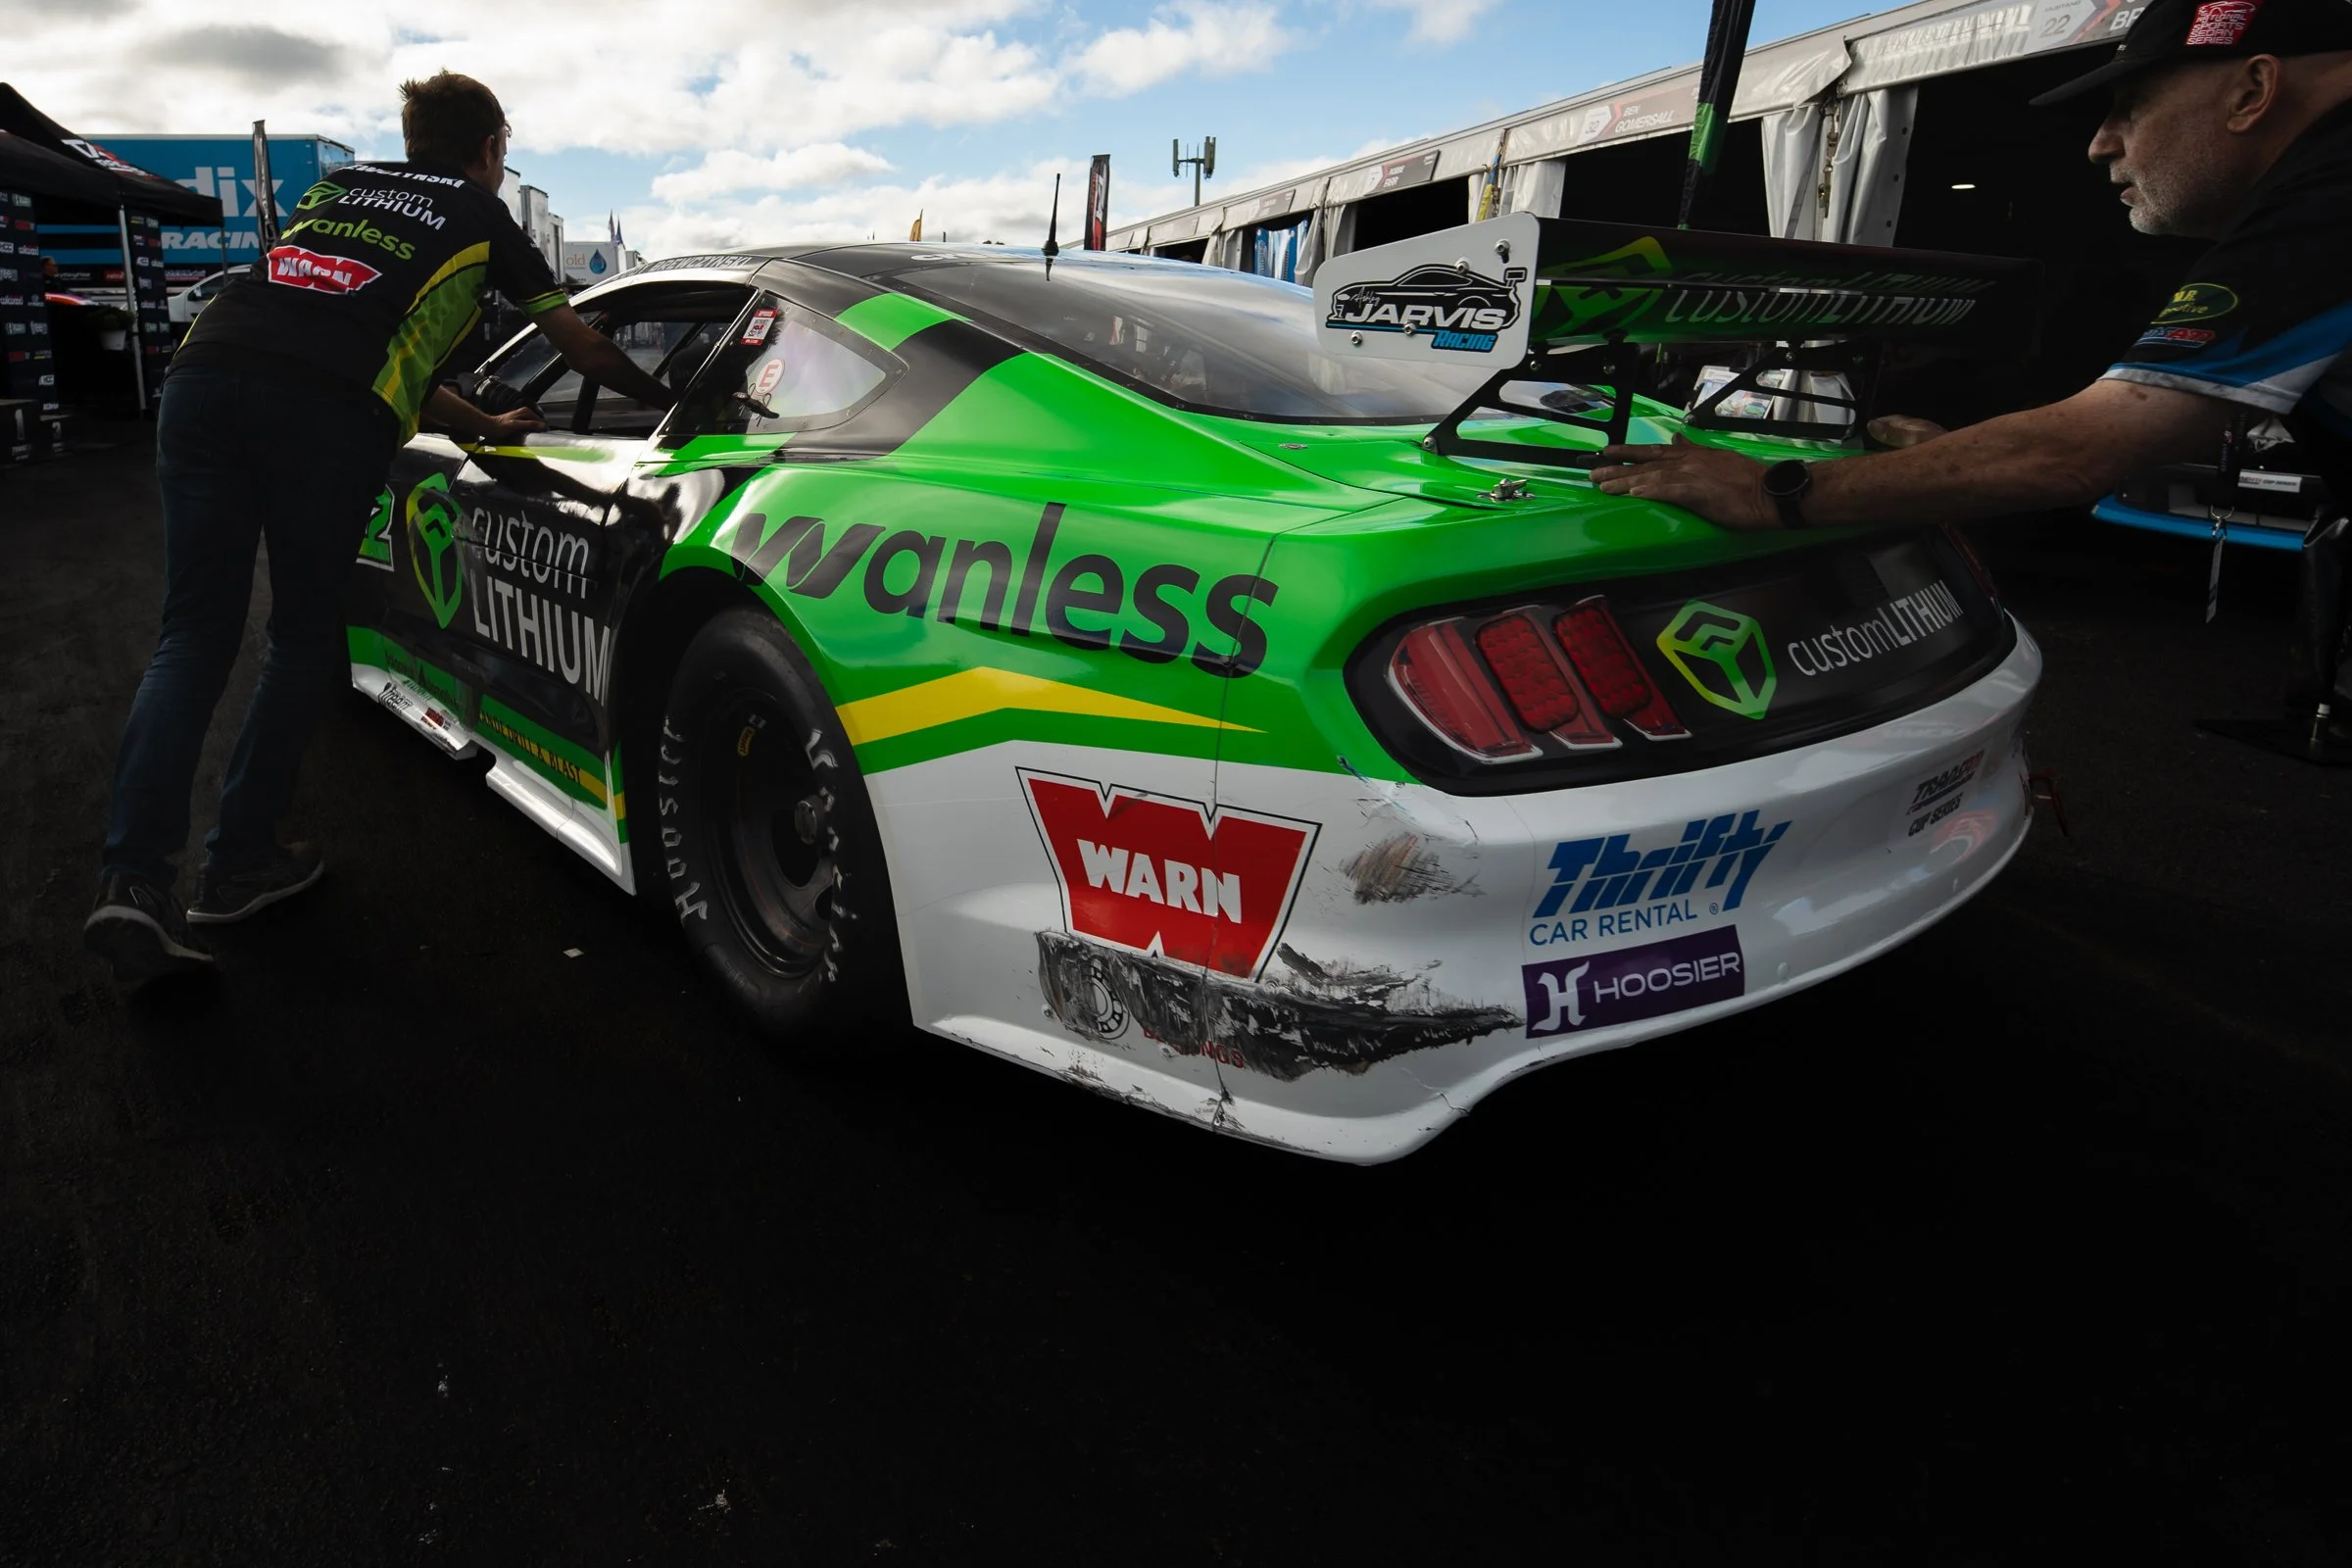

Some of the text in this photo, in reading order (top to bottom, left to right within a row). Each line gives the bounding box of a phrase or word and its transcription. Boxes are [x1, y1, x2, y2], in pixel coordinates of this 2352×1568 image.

[2039, 15, 2071, 38] 22
[2185, 36, 2234, 46] SERIES
[2189, 29, 2234, 38] SEDAN
[2193, 22, 2246, 31] SPORTS
[1614, 110, 1675, 133] GOMERSALL
[1623, 105, 1642, 117] BEN
[337, 195, 447, 231] LITHIUM
[349, 187, 434, 209] custom
[280, 219, 416, 262] wanless
[276, 257, 352, 286] WARN
[1345, 303, 1507, 331] JARVIS
[759, 364, 780, 388] E
[472, 506, 590, 600] custom
[731, 501, 1280, 679] wanless
[469, 568, 612, 705] LITHIUM
[549, 751, 581, 785] BLAST
[1532, 808, 1793, 919] Thrifty
[1076, 837, 1243, 924] WARN
[1529, 899, 1697, 947] CAR RENTAL
[1592, 951, 1741, 1004] HOOSIER
